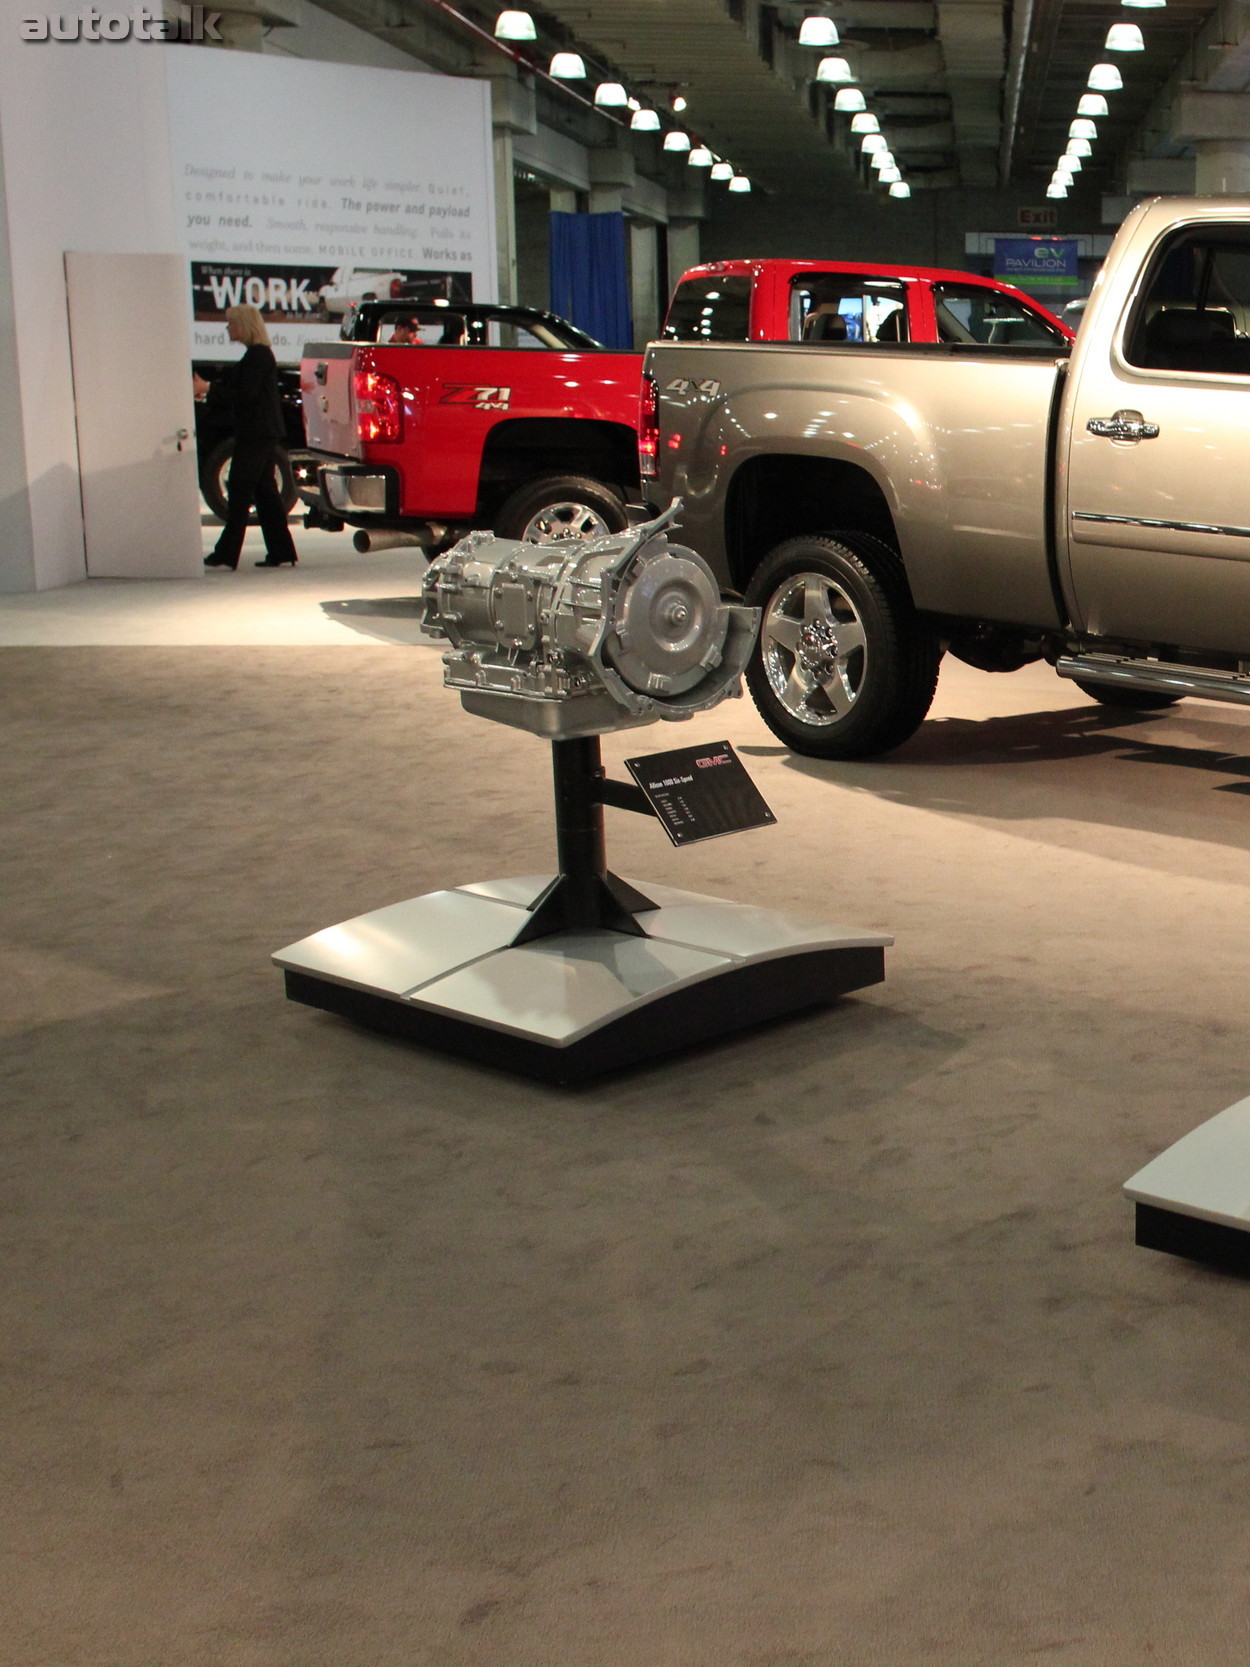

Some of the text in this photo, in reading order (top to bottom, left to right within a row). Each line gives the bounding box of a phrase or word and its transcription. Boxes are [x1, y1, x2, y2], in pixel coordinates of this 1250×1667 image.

[185, 190, 285, 206] comfortable
[341, 197, 361, 211] The
[365, 201, 400, 214] power
[405, 203, 425, 215] and
[428, 205, 471, 219] payload
[187, 214, 211, 228] you
[218, 214, 252, 228] need.
[319, 245, 364, 257] MOBILE
[422, 247, 457, 261] Works
[460, 251, 472, 261] as
[1006, 258, 1066, 268] PAVILION
[209, 276, 312, 311] WORK
[194, 333, 225, 345] hard
[439, 383, 511, 405] Z71
[696, 754, 732, 769] GMC
